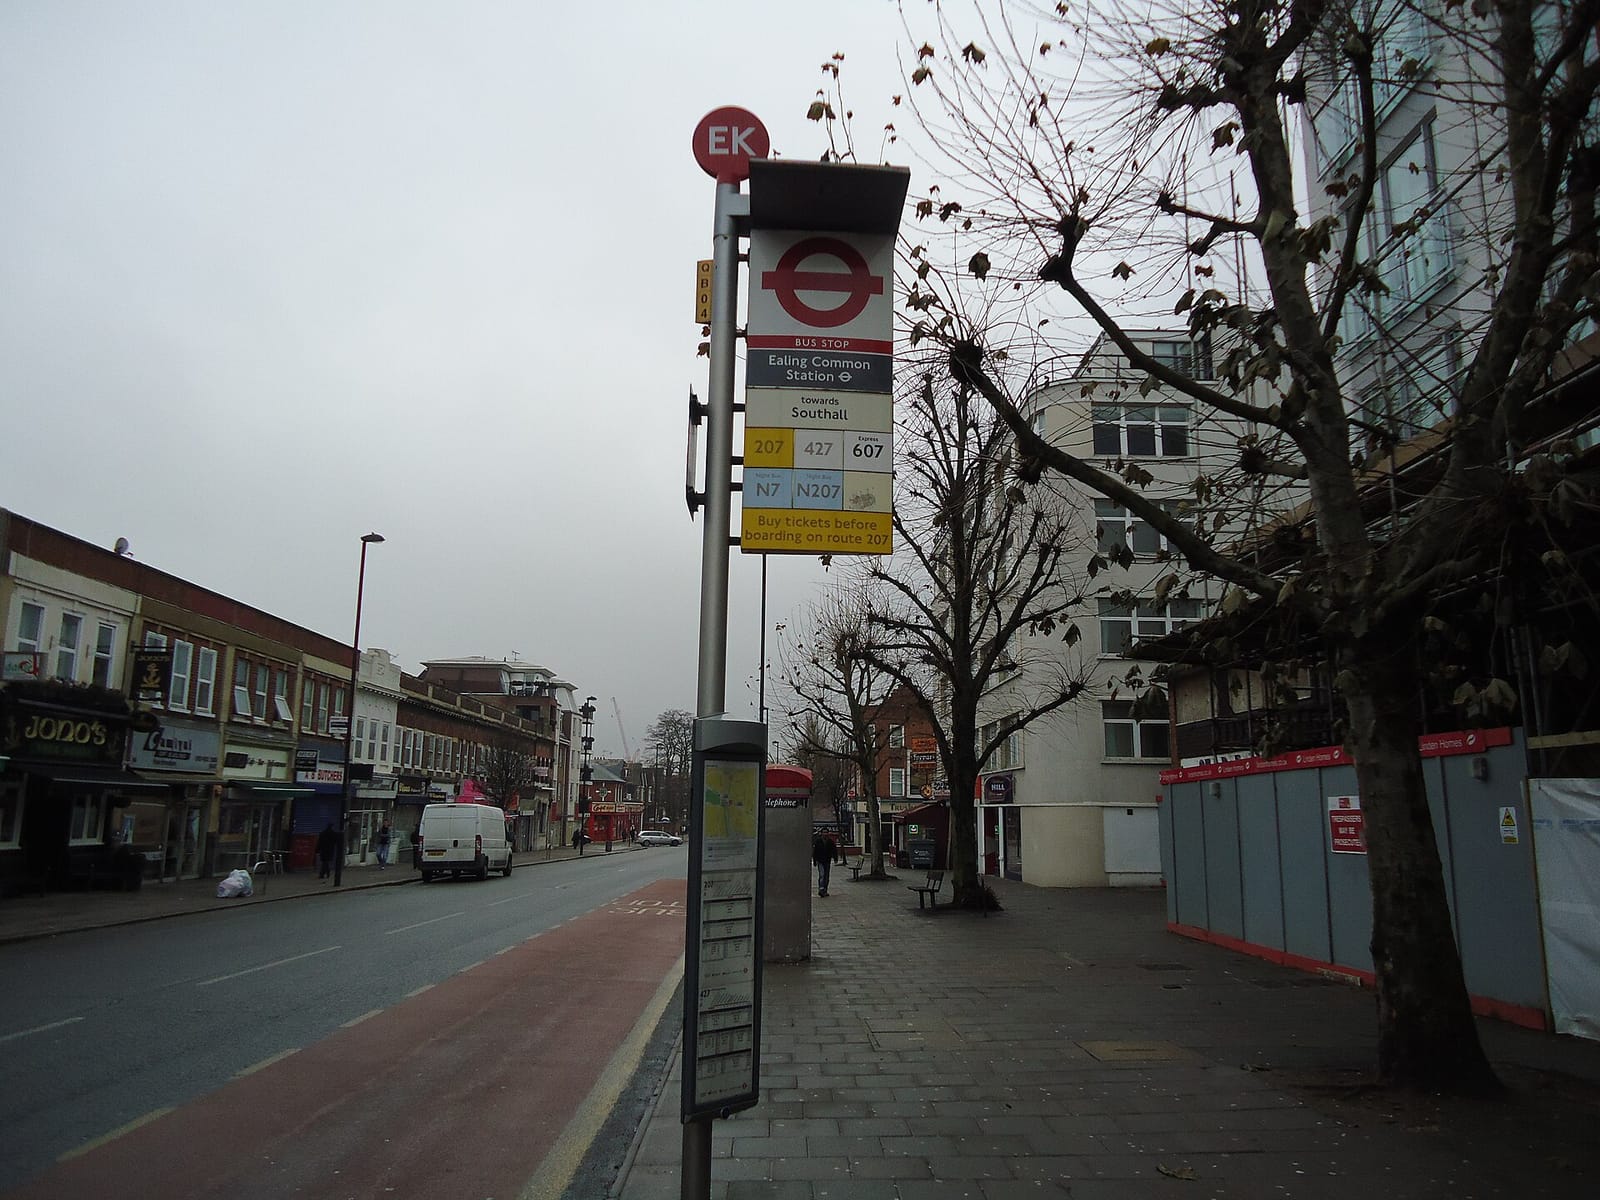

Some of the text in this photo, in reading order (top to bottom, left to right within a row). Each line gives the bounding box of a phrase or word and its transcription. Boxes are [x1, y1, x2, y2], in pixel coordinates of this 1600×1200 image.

[709, 126, 756, 156] EK
[795, 338, 849, 349] BUS STOP
[768, 354, 871, 370] Ealing Common
[786, 369, 834, 382] Station
[801, 396, 839, 406] towards
[791, 407, 848, 420] Southall
[754, 440, 784, 454] 207
[804, 441, 833, 456] 427
[853, 444, 884, 458] 607
[756, 482, 781, 497] N7
[797, 482, 841, 499] N207
[758, 515, 877, 530] Buy tickets before
[745, 530, 888, 545] boarding on route 207
[765, 797, 797, 808] elephone
